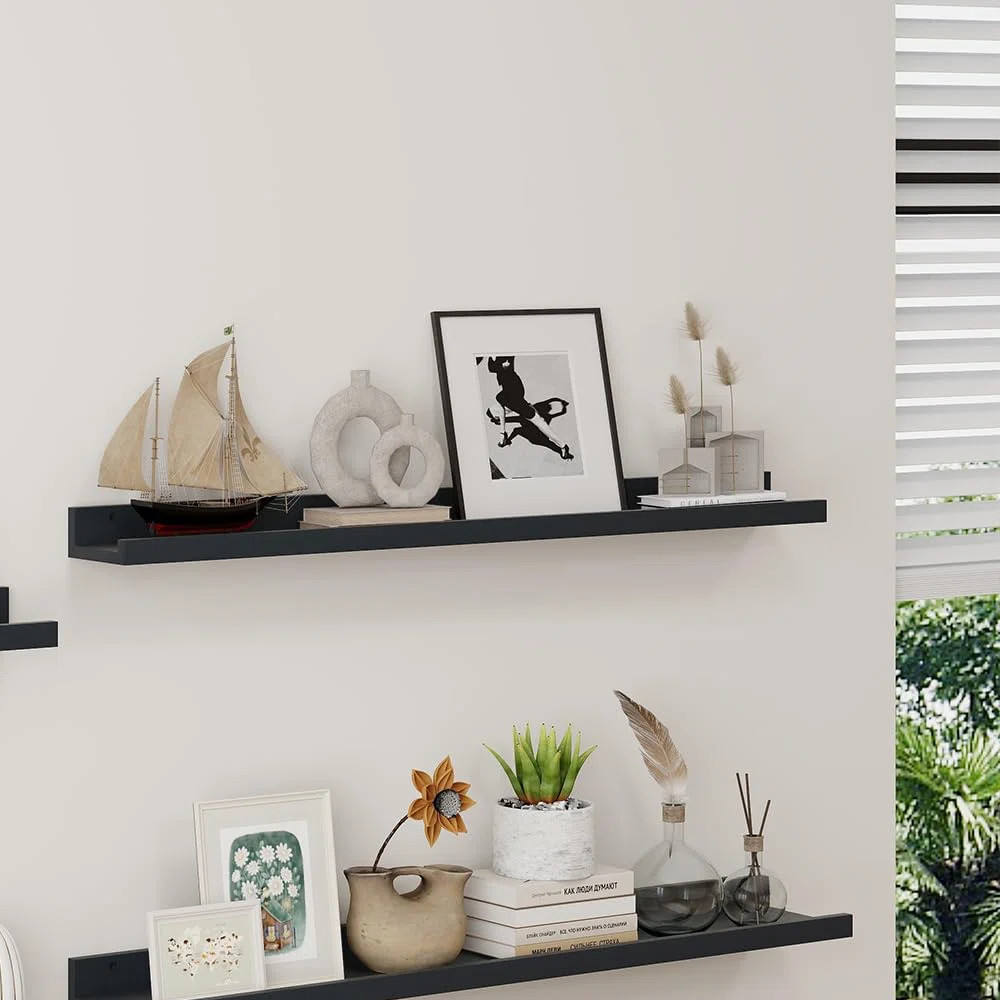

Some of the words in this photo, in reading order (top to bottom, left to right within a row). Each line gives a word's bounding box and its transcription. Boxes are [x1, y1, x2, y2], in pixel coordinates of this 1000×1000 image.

[563, 887, 576, 896] КАК
[576, 885, 593, 894] ЛЮДИ
[593, 881, 618, 892] ДУМАЮТ
